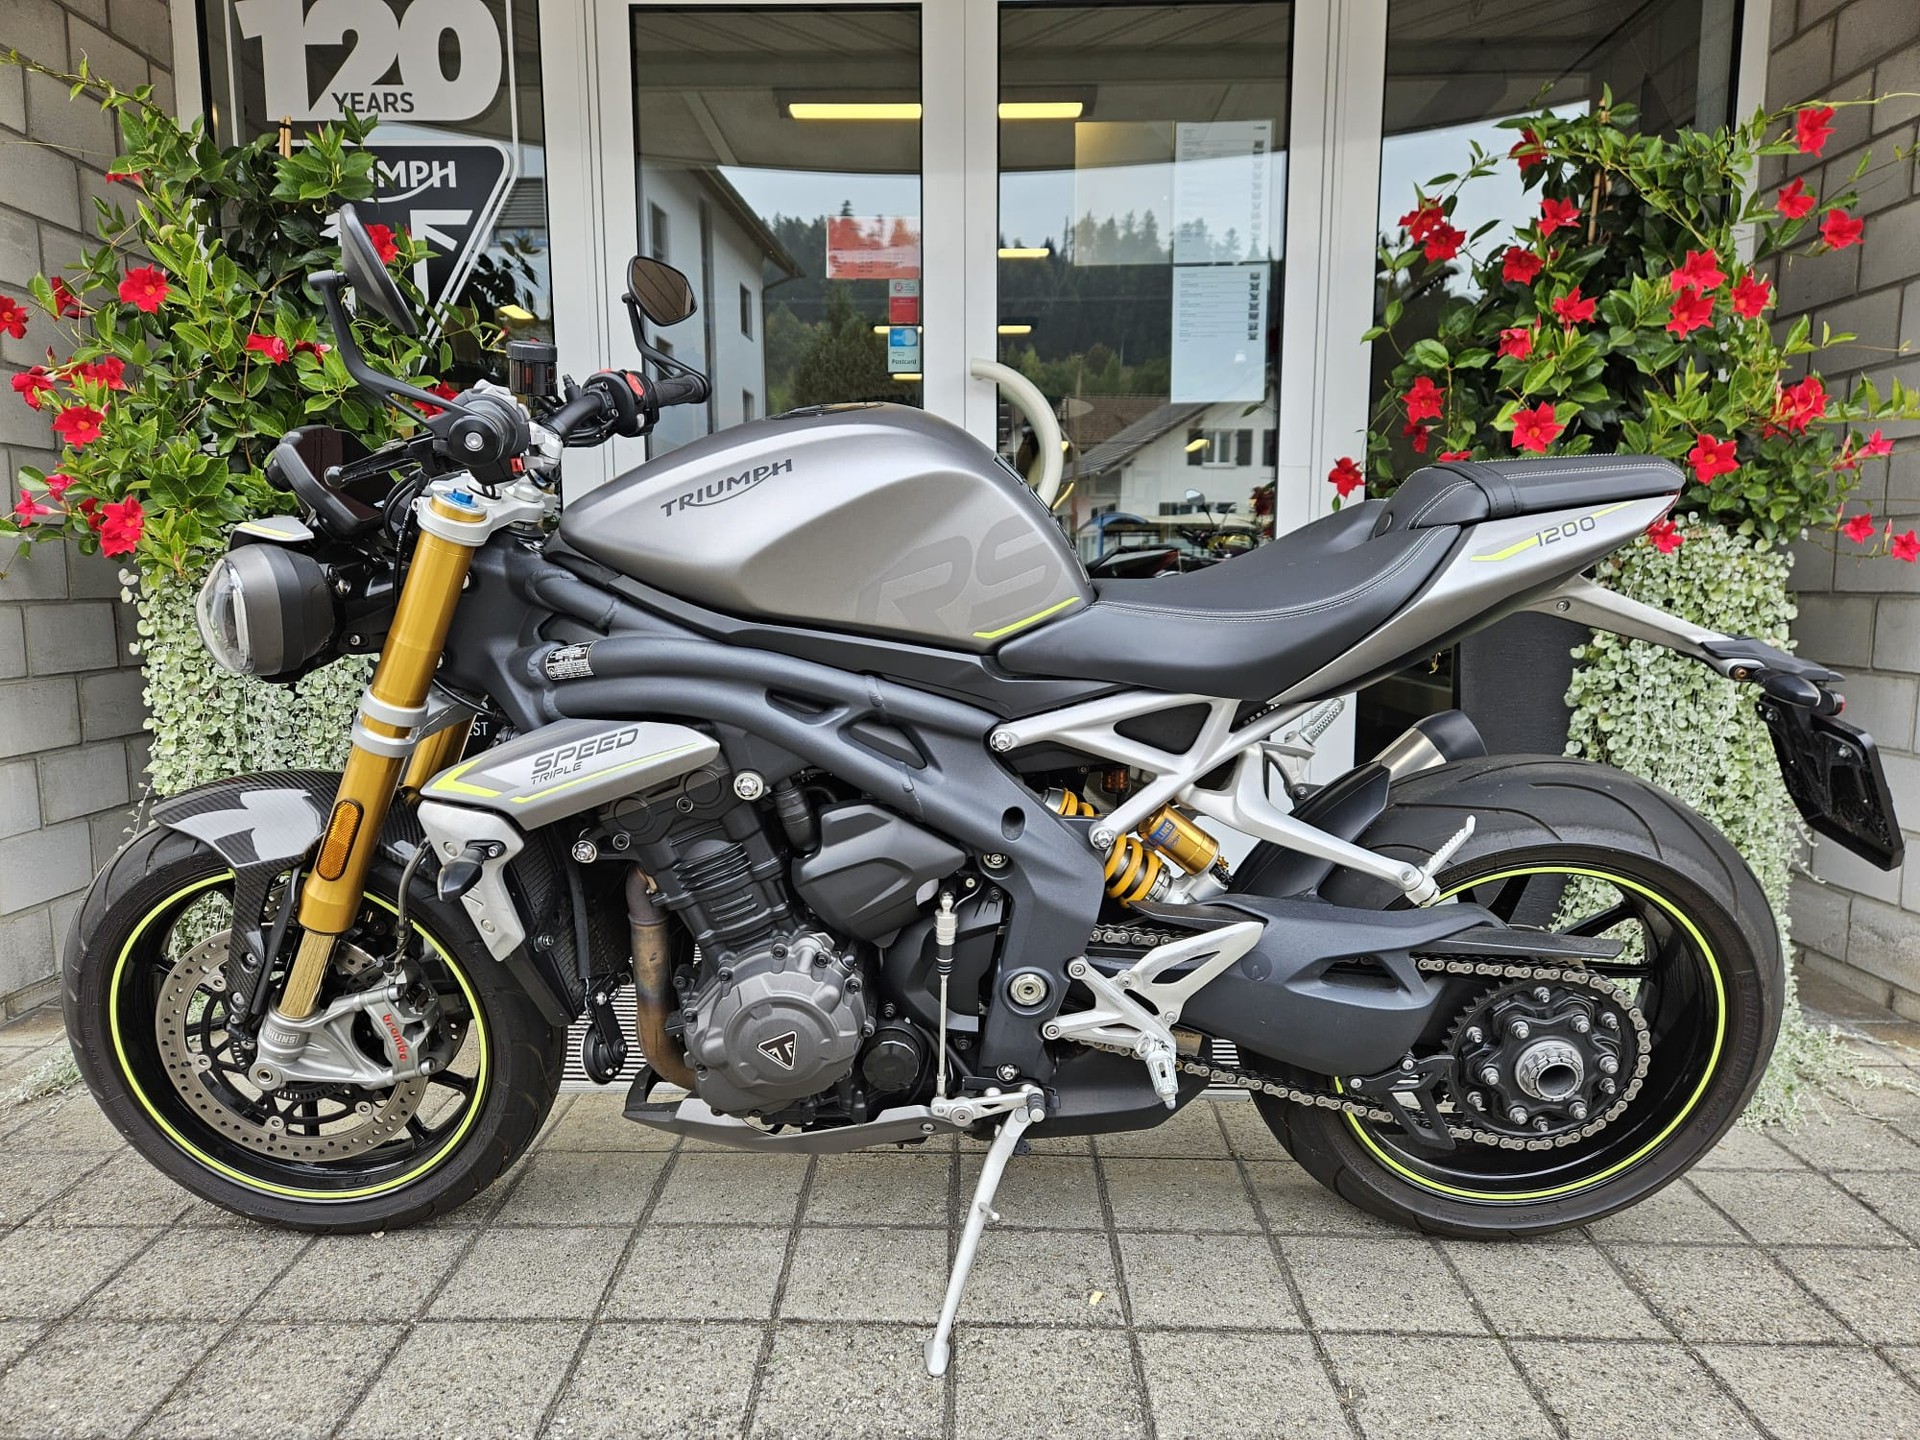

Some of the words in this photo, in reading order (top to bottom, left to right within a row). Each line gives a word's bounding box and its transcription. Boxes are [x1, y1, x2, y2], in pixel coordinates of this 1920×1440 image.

[235, 0, 502, 121] 120
[331, 92, 415, 114] YEARS
[660, 458, 793, 517] TRIUMPH
[1535, 516, 1596, 547] 1200
[856, 513, 1063, 633] RS
[531, 761, 583, 785] TRIPLE
[532, 728, 639, 775] SPEED
[383, 1013, 408, 1060] brembo
